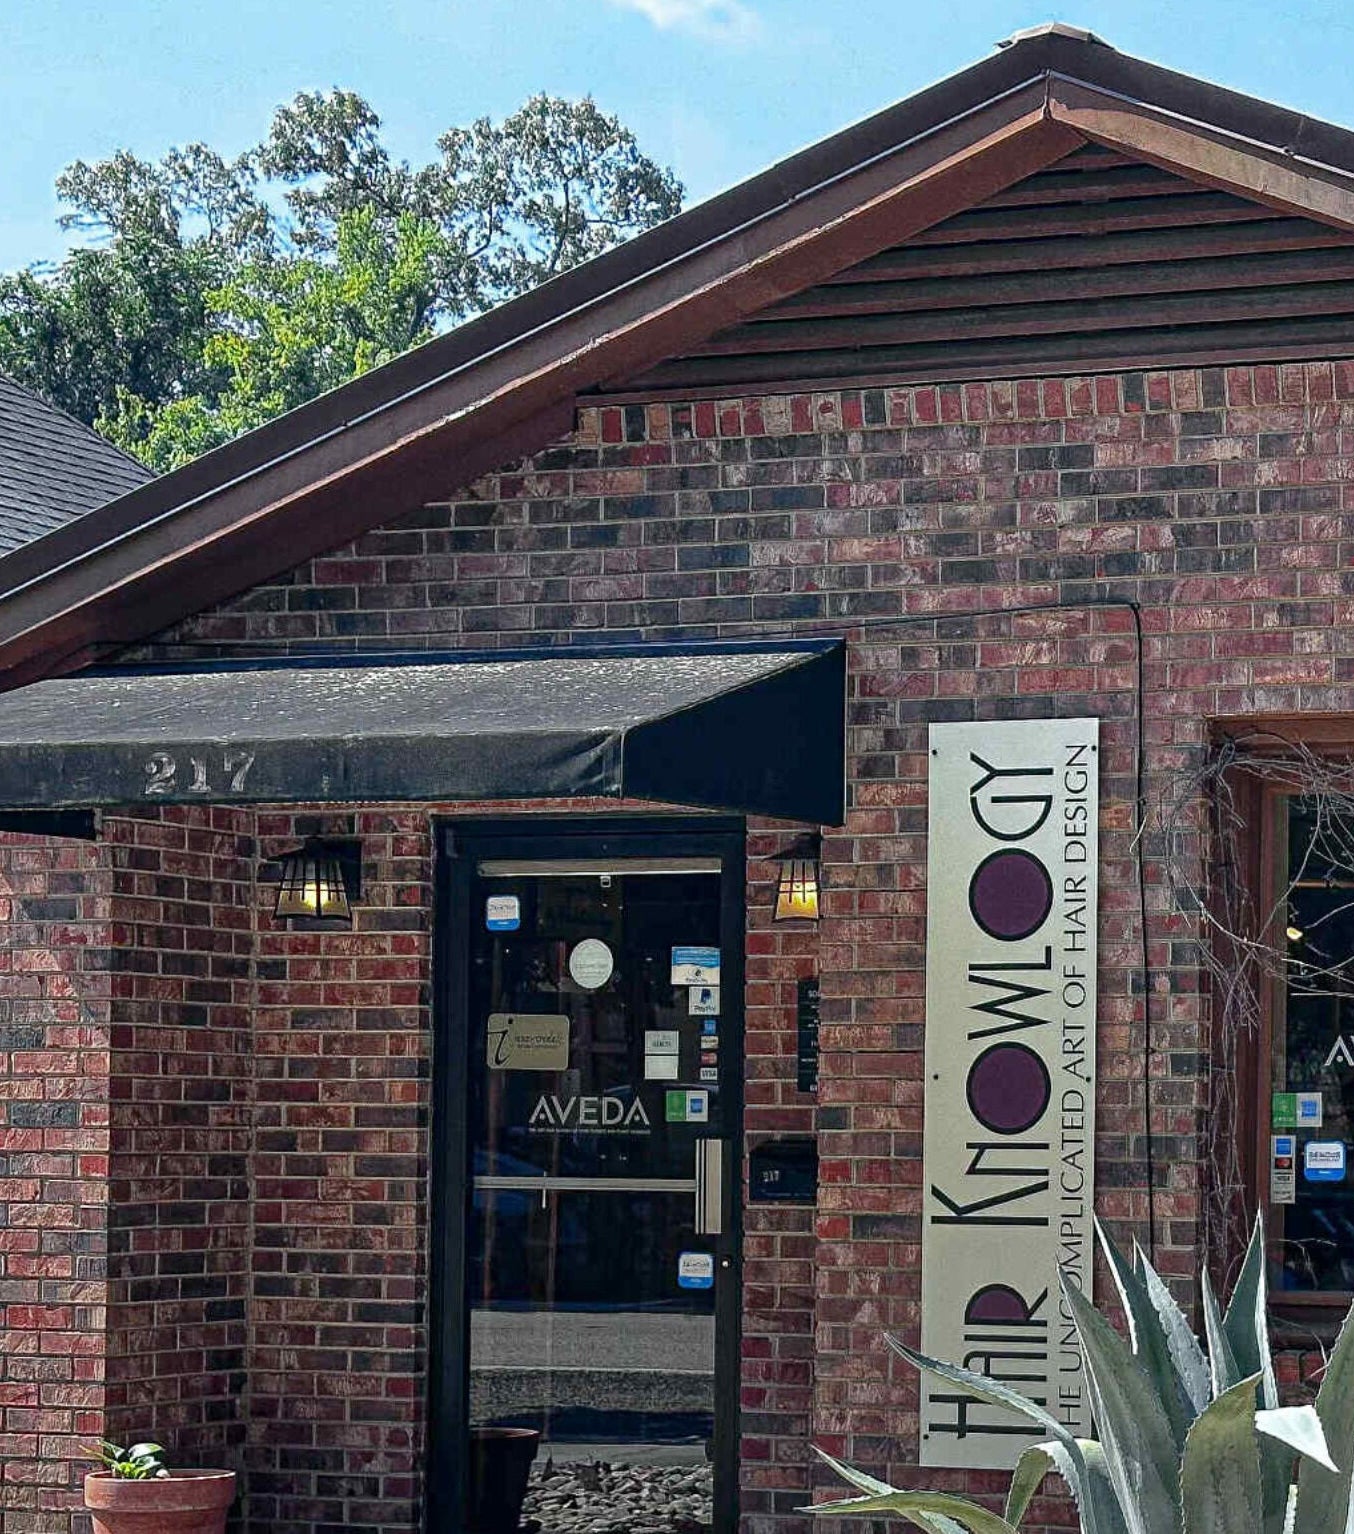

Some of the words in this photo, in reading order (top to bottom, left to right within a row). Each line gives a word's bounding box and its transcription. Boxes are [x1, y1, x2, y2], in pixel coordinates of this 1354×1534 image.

[144, 750, 255, 795] 217
[1063, 744, 1090, 864] DESIGN
[1063, 875, 1088, 953] HAIR
[1062, 965, 1088, 1009] OF
[1061, 1019, 1087, 1080] ART
[528, 1095, 650, 1126] AVEDA
[928, 1283, 1048, 1440] HAIR
